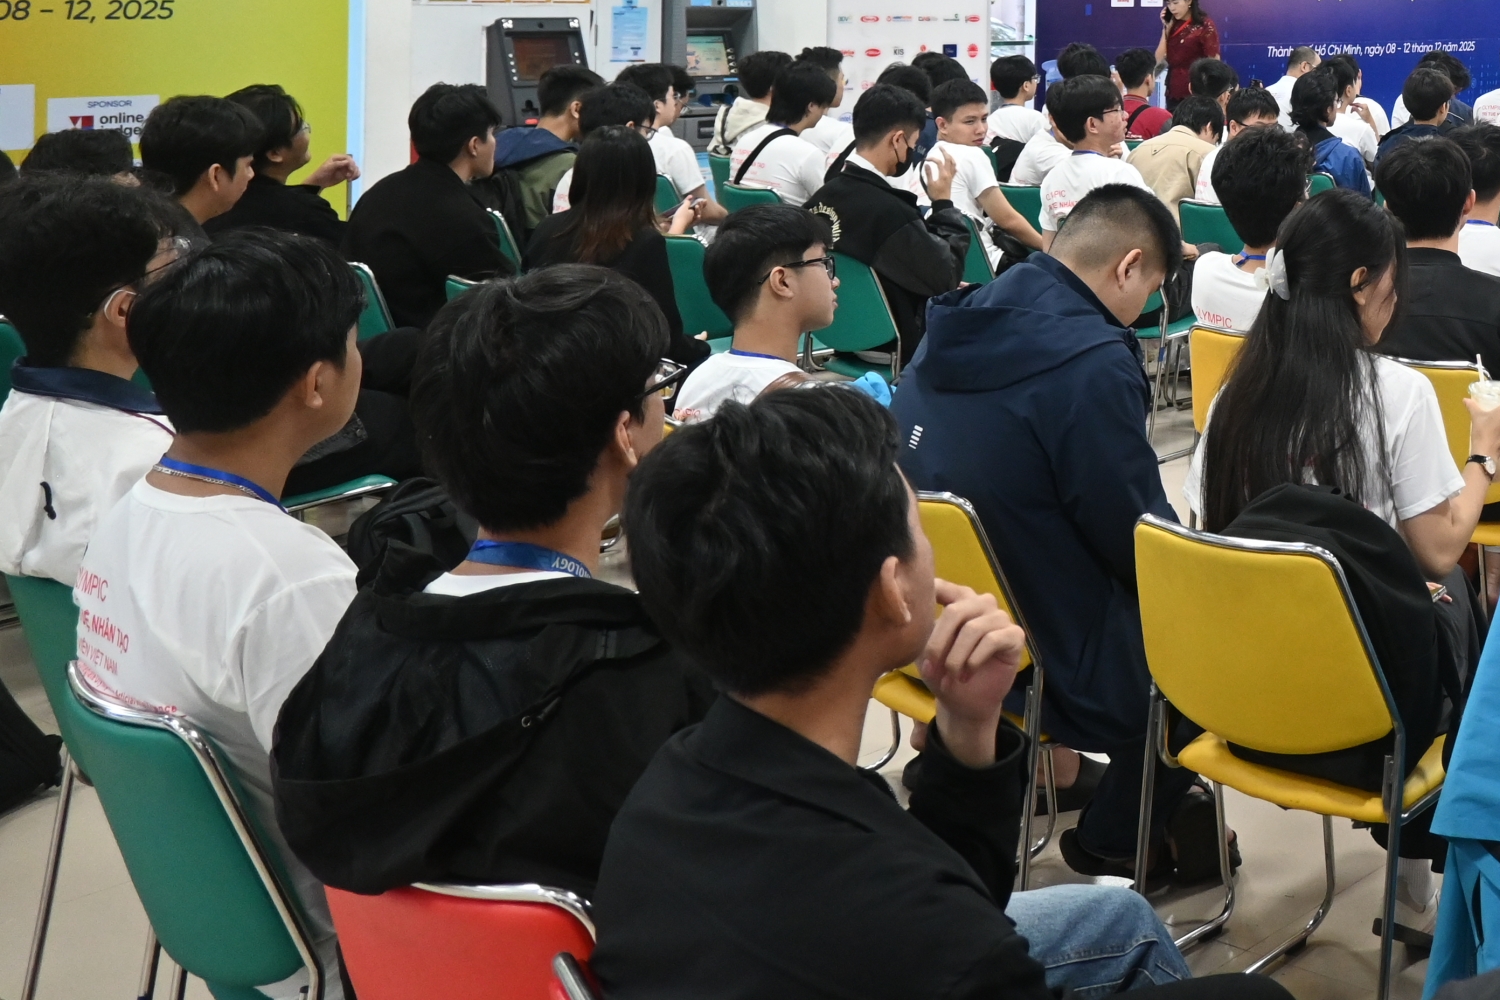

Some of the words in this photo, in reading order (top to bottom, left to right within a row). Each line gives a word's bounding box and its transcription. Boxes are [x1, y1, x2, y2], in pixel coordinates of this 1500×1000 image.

[65, 0, 97, 23] 12,
[105, 0, 174, 20] 2025
[1328, 43, 1341, 55] Chí
[1364, 44, 1385, 56] ngày
[1386, 43, 1396, 54] 08
[1403, 43, 1410, 54] 12
[1459, 41, 1476, 52] 2025
[87, 100, 132, 108] SPONSOR
[100, 112, 144, 124] online
[91, 614, 117, 644] NHÂN
[117, 627, 130, 654] TẠO
[104, 654, 119, 676] NAM
